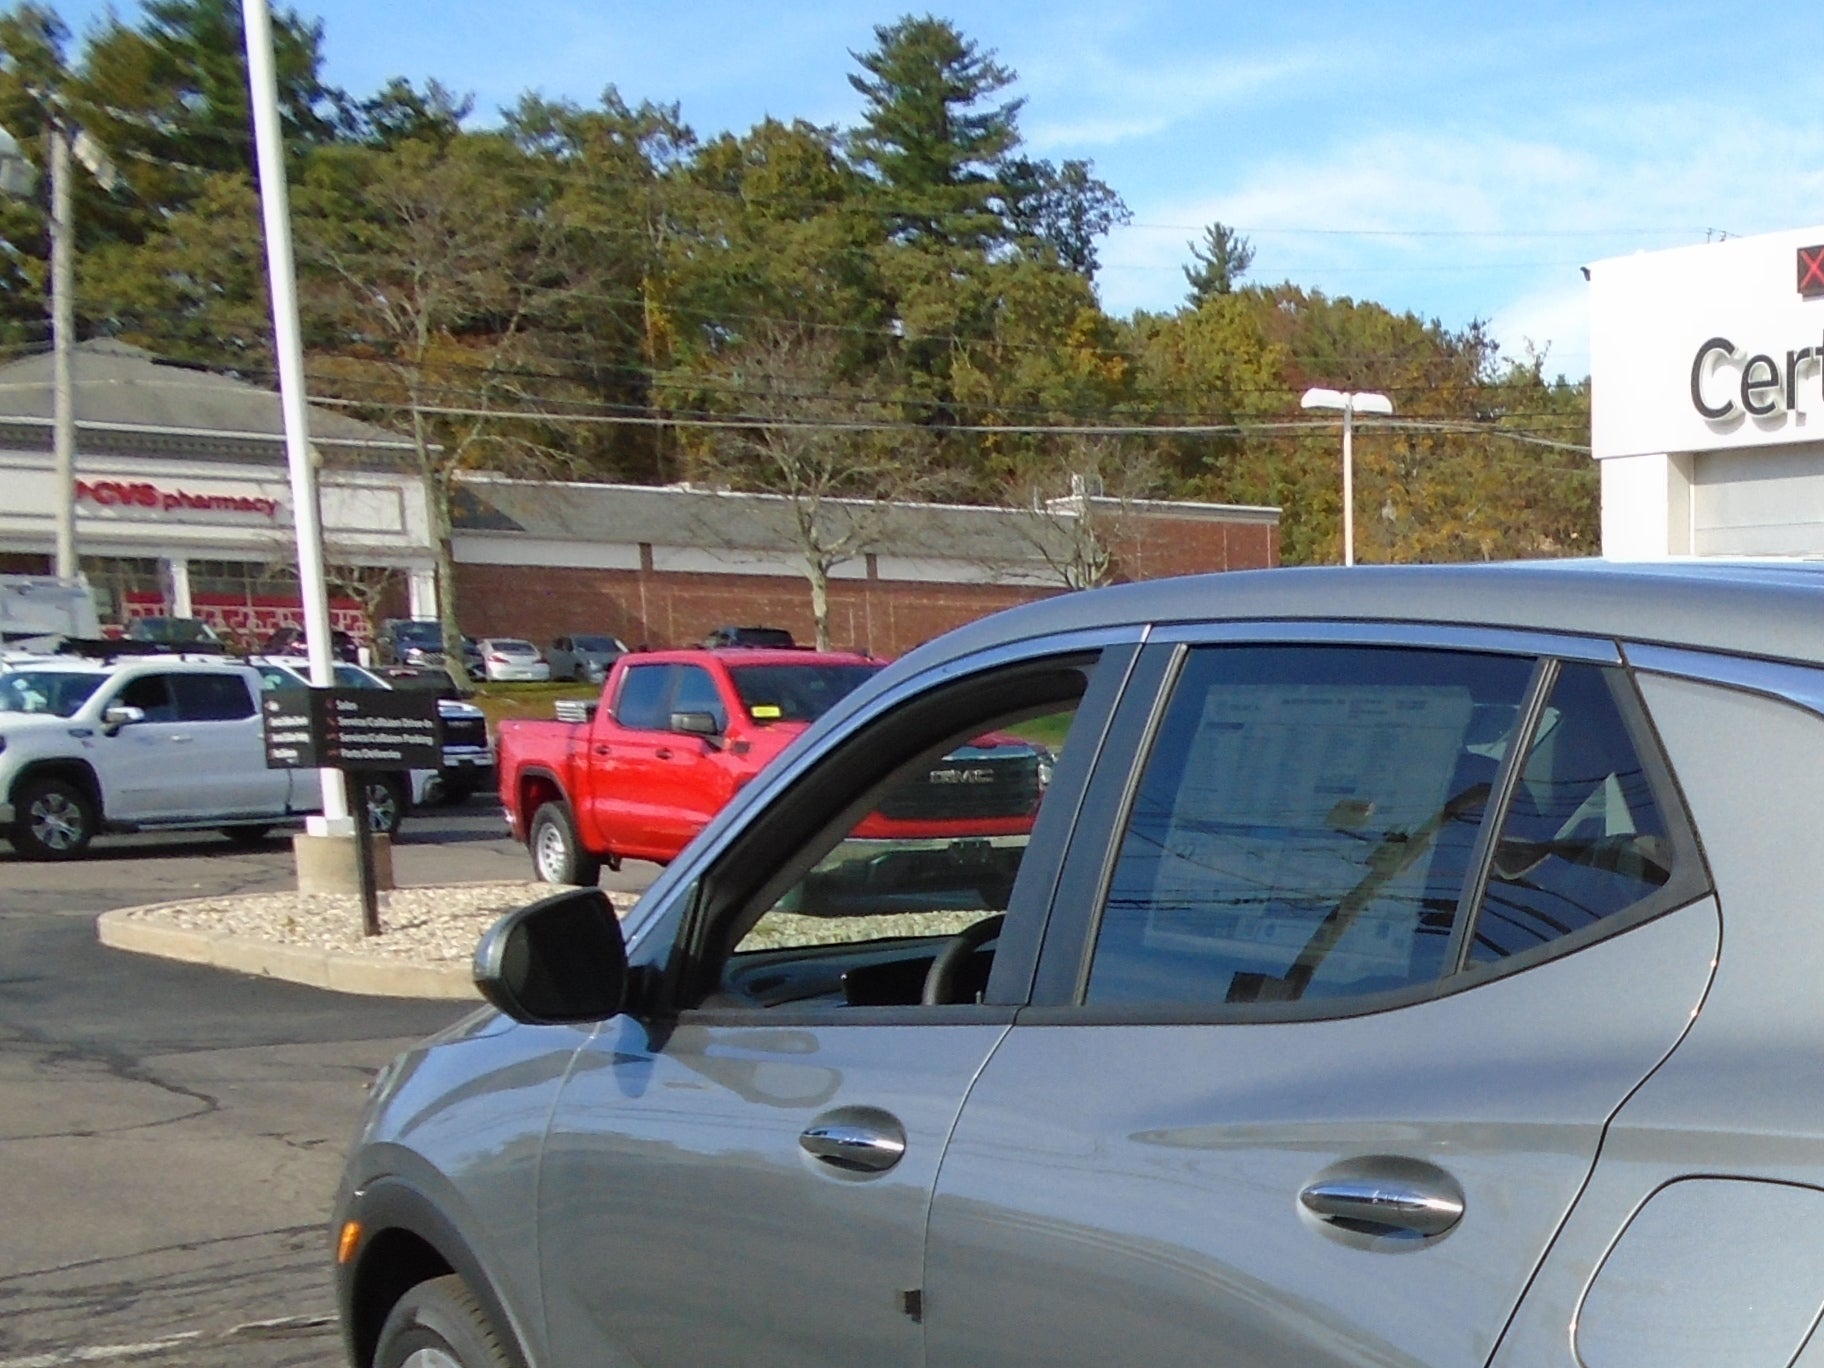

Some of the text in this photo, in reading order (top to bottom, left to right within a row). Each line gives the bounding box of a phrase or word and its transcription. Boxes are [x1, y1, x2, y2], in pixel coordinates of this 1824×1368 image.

[94, 478, 276, 516] CVS pharmacy
[930, 769, 994, 784] GMC
